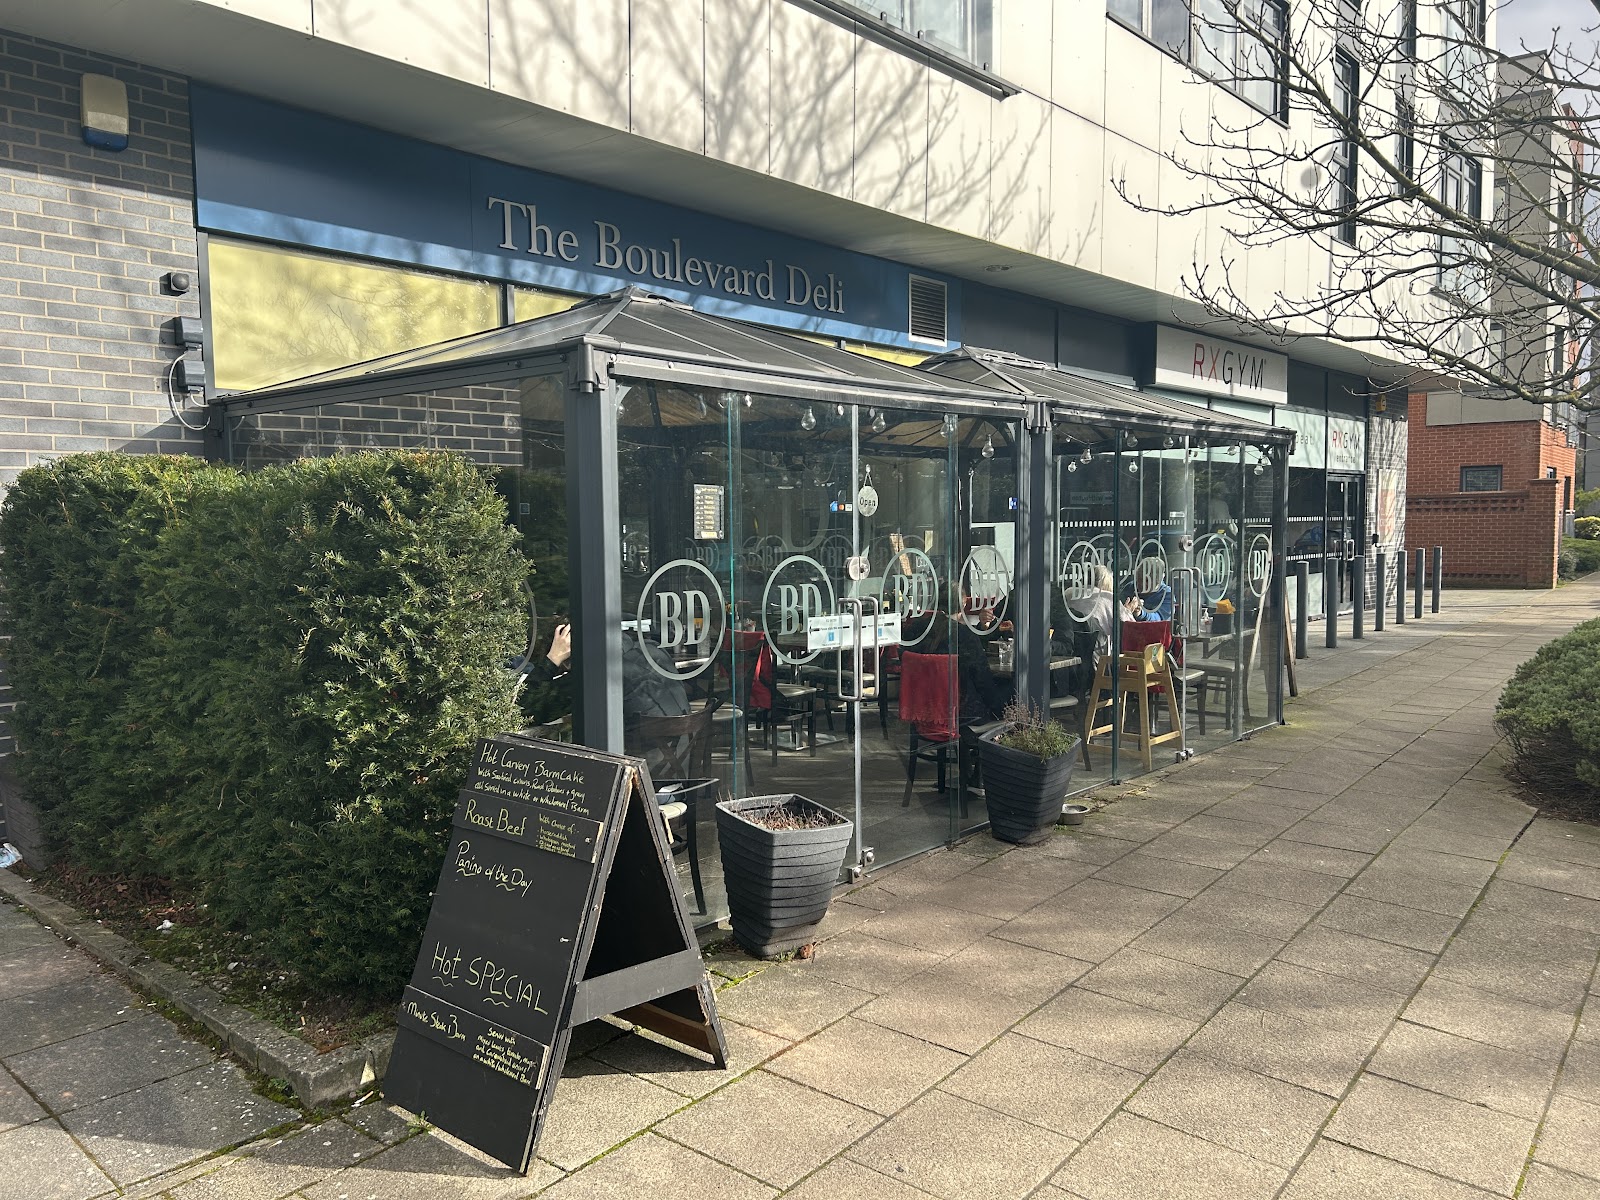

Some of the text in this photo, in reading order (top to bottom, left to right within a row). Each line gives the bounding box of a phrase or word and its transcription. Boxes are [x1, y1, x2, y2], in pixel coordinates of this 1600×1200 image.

[488, 196, 846, 314] The Boulevard Deli
[1192, 342, 1264, 391] RXGYM
[1331, 430, 1360, 450] RXGYM
[860, 496, 876, 508] Open
[1071, 561, 1096, 601] BD
[1141, 557, 1163, 594] BD
[1208, 552, 1225, 587] BD
[777, 583, 822, 636] BD
[892, 573, 929, 622] BD
[970, 569, 1001, 612] BD
[656, 589, 711, 650] BD
[480, 743, 498, 764] Hot
[501, 748, 530, 777] Carvery
[464, 799, 527, 836] Roast Beef
[513, 789, 531, 800] white
[571, 802, 590, 816] Barm
[455, 840, 533, 897] Panino of the Day
[431, 941, 461, 979] Hot
[430, 1012, 447, 1032] Steak
[447, 1014, 466, 1042] Barm
